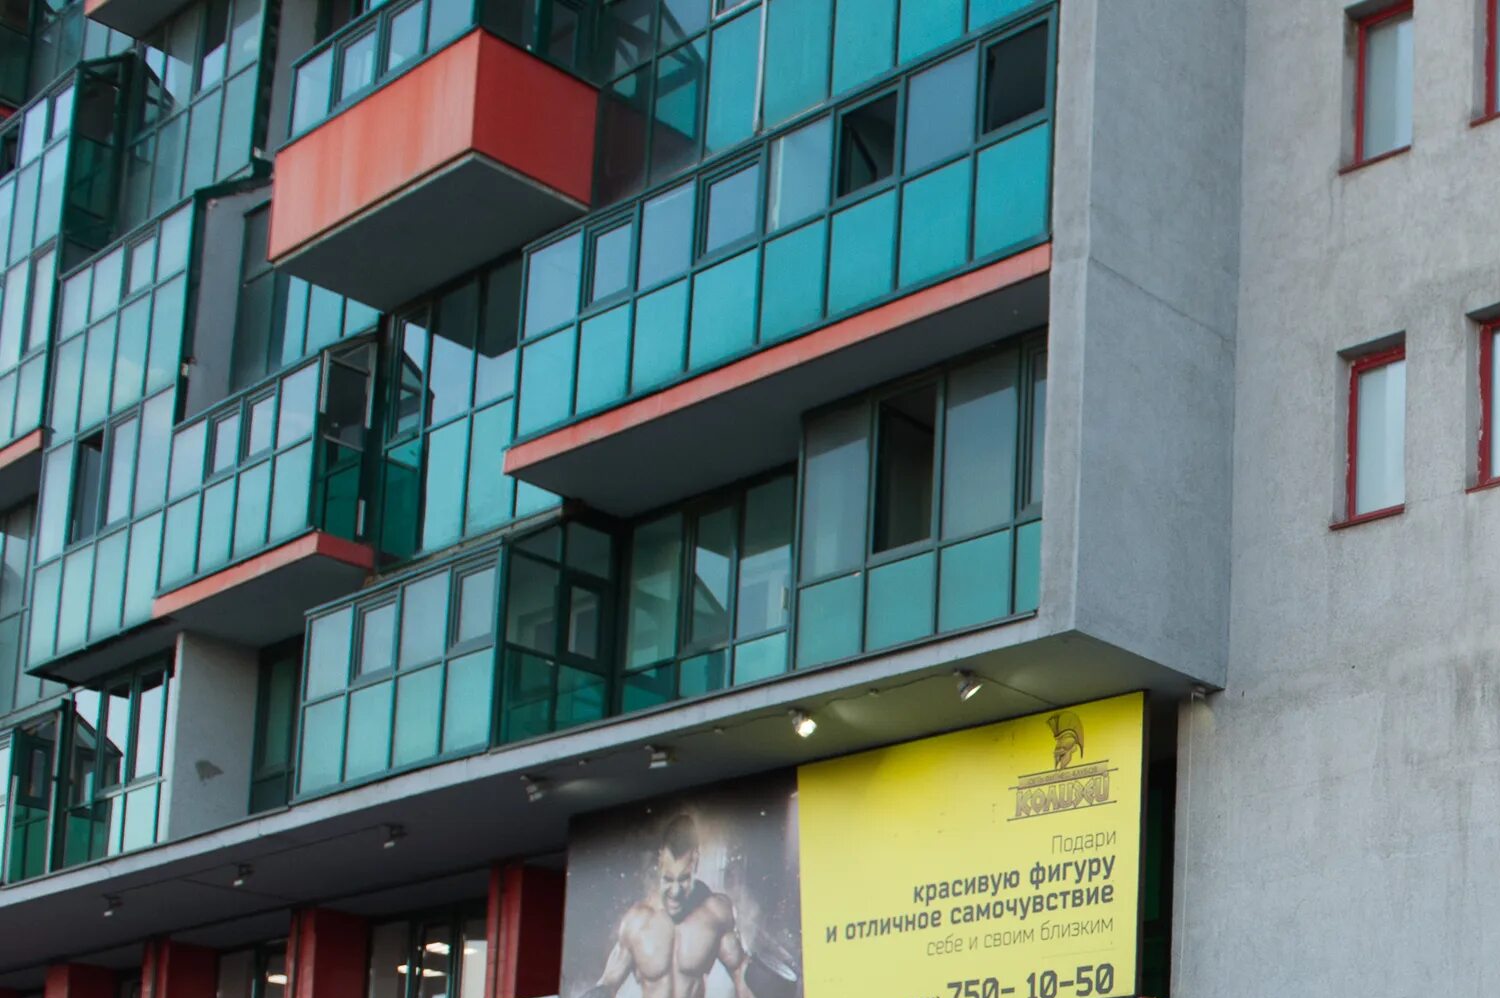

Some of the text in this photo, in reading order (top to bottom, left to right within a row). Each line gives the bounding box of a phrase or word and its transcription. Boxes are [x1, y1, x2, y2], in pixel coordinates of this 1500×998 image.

[1051, 830, 1117, 855] Подари
[913, 855, 1116, 906] красивую фигуру
[826, 884, 1114, 944] и отличное самочувствие
[927, 917, 1114, 957] себе и своим близким
